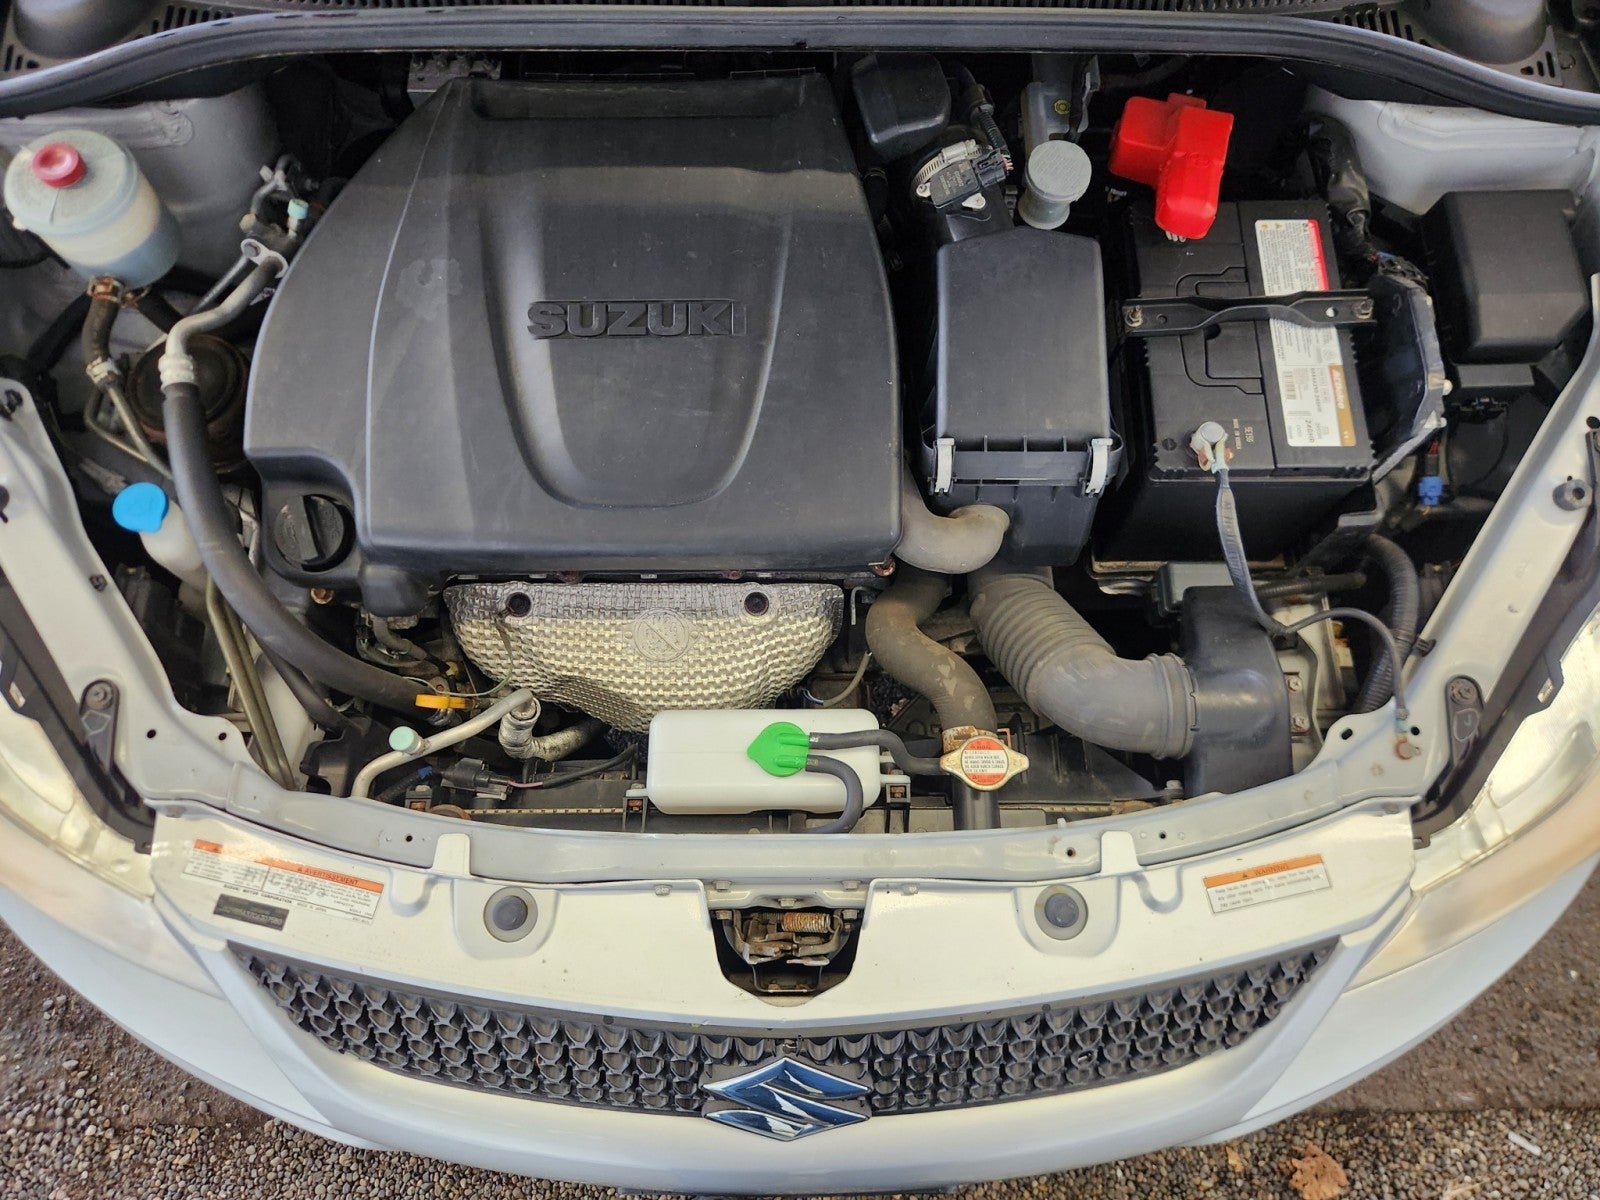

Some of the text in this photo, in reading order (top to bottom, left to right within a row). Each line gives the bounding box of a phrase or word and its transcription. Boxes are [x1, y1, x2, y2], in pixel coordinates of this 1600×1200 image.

[527, 300, 748, 337] SUZUKI
[305, 868, 359, 886] AVERTISSEMENT
[1254, 863, 1290, 876] WARNING
